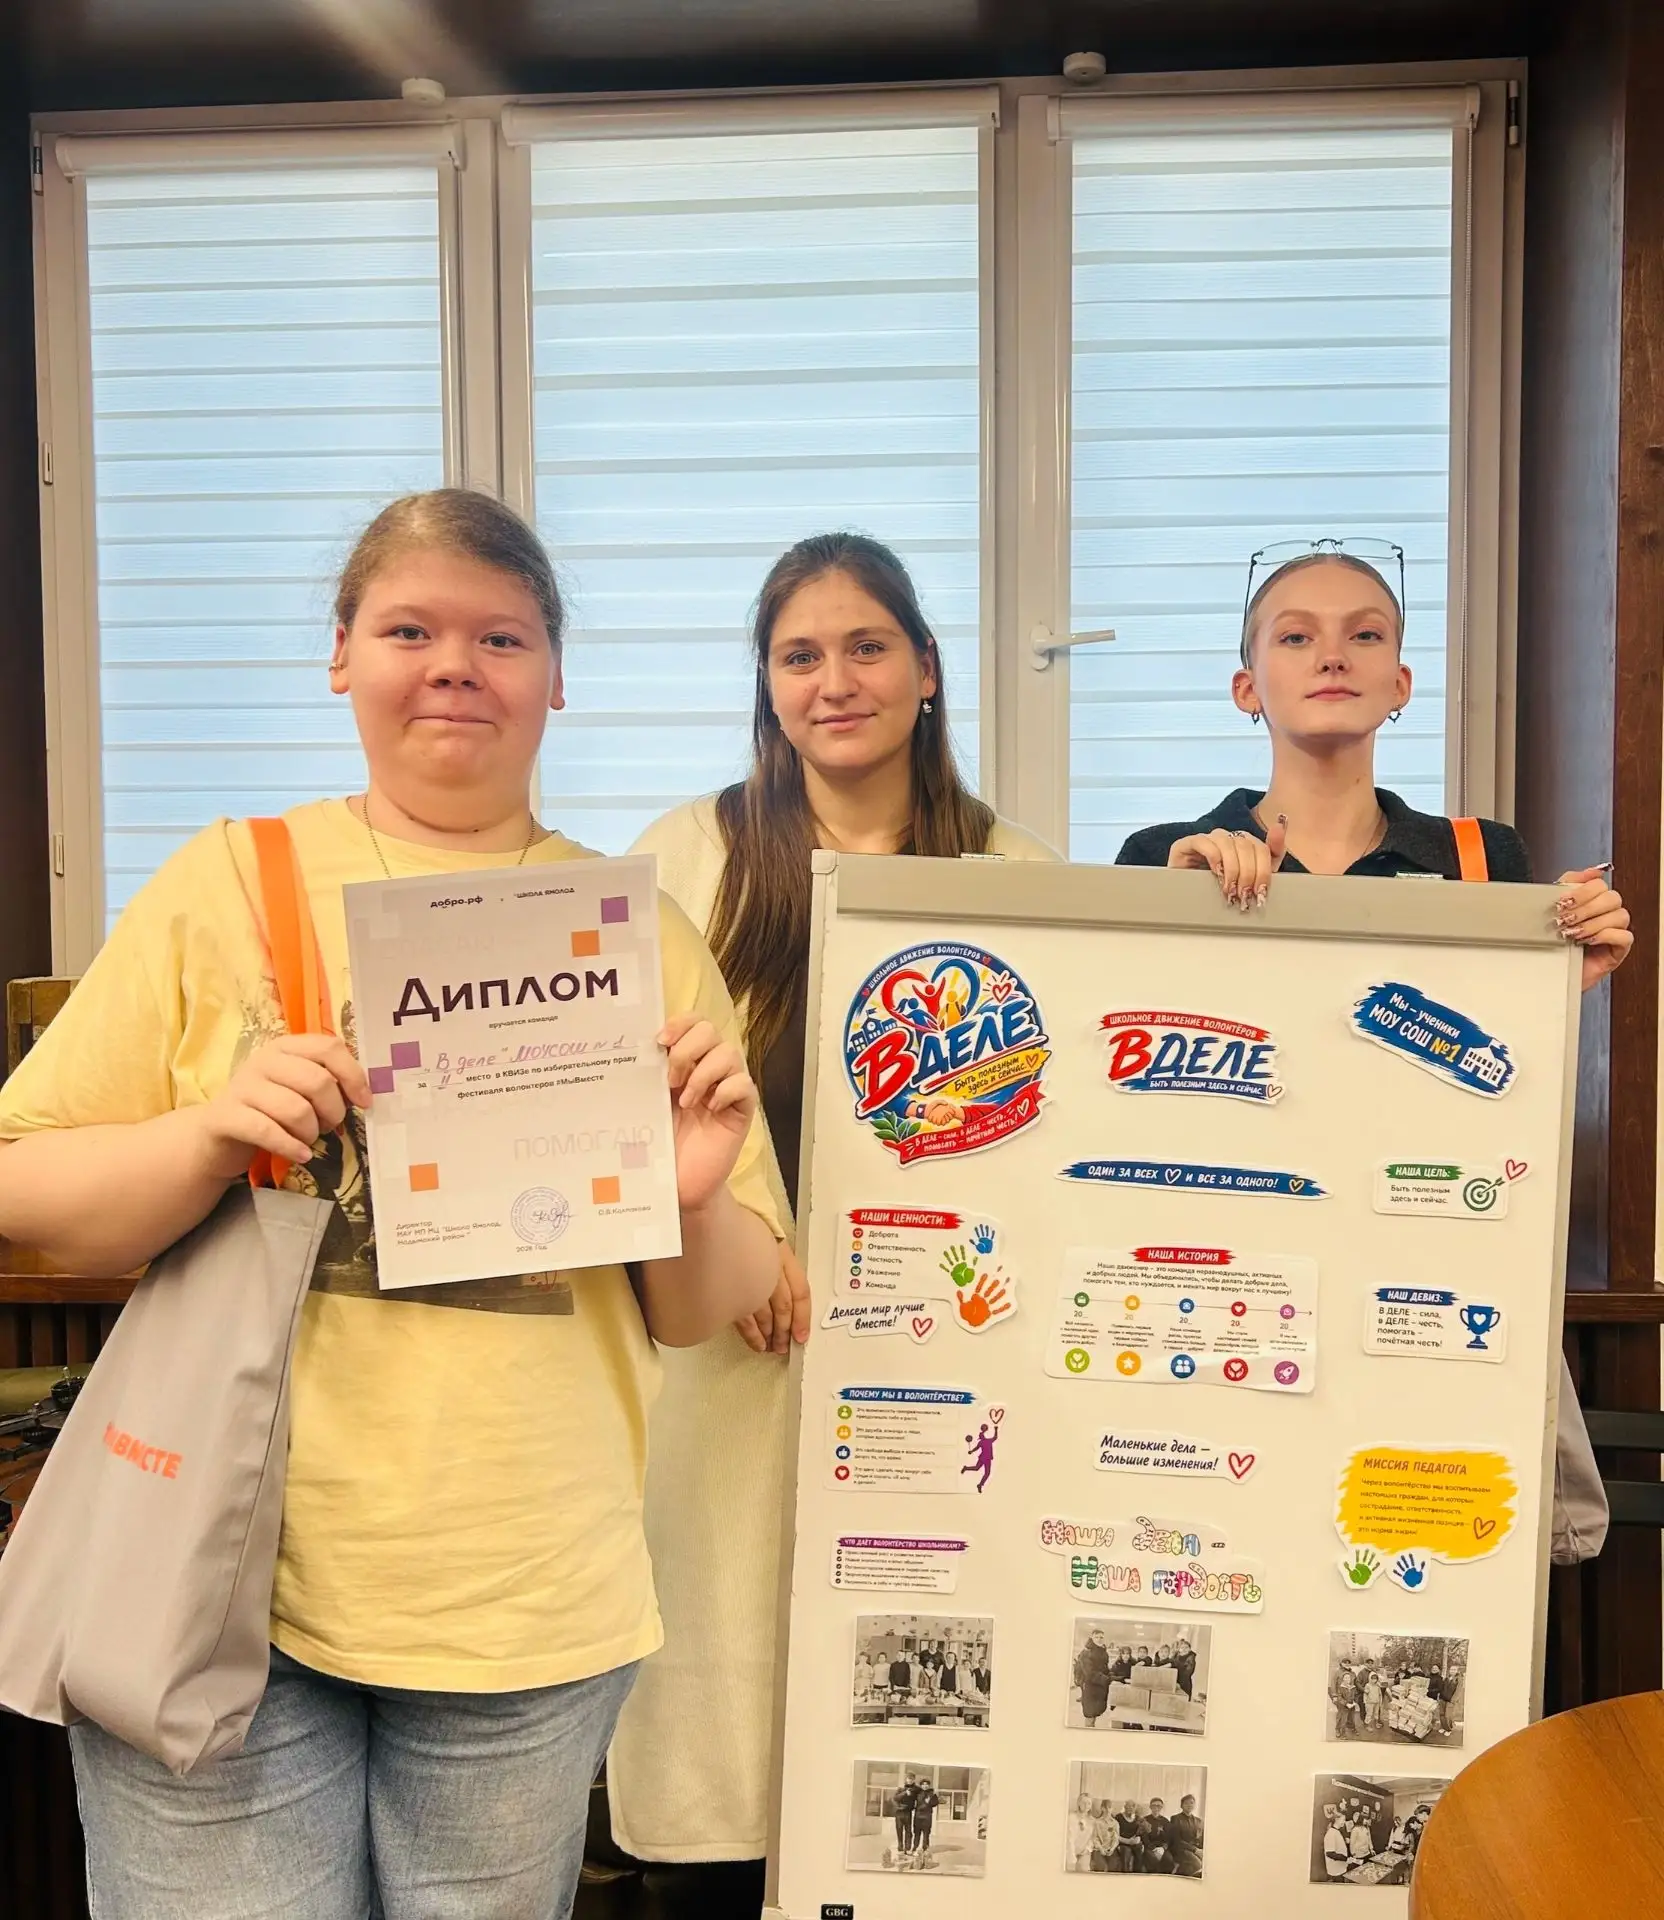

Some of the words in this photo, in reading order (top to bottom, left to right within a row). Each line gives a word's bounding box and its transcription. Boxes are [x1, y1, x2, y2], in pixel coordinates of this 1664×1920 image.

[430, 895, 484, 908] добро.рф
[868, 960, 899, 989] ШКОЛЬНОЕ
[899, 946, 935, 966] ДВИЖЕНИЕ
[392, 968, 619, 1027] Диплом
[1389, 992, 1409, 1011] Мы
[1416, 1010, 1461, 1039] ученики
[489, 1019, 526, 1029] вручается
[1109, 1013, 1152, 1026] ШКОЛЬНОЕ
[1154, 1014, 1201, 1027] ДВИЖЕНИЕ
[1203, 1019, 1258, 1038] ВОЛОНТЁРОВ
[1368, 1003, 1402, 1030] МОУ
[1400, 1020, 1433, 1048] СОШ
[1429, 1036, 1462, 1064] №1
[852, 1028, 916, 1113] В
[912, 998, 1035, 1086] ДЕЛЕ
[1107, 1028, 1153, 1081] В
[1144, 1032, 1277, 1080] ДЕЛЕ
[465, 1073, 491, 1082] место
[531, 1066, 542, 1074] по
[543, 1057, 611, 1073] избирательному
[613, 1055, 638, 1066] праву
[954, 1075, 976, 1092] Быть
[978, 1056, 1019, 1079] полезным
[457, 1088, 504, 1099] фестиваля
[505, 1081, 555, 1093] волонтеров
[968, 1079, 989, 1094] здесь
[1149, 1080, 1169, 1088] БЫТЬ
[1170, 1080, 1207, 1089] ПОЛЕЗНЫМ
[1208, 1081, 1228, 1091] ЗДЕСЬ
[1229, 1083, 1235, 1091] И
[1087, 1164, 1115, 1177] ОДИН
[1118, 1166, 1131, 1178] ЗА
[1134, 1167, 1159, 1180] ВСЕХ
[1185, 1171, 1193, 1182] И
[1197, 1173, 1217, 1185] ВСЕ
[1219, 1174, 1233, 1186] ЗА
[1236, 1175, 1278, 1188] ОДНОГО!
[1395, 1166, 1422, 1177] НАША
[1423, 1166, 1450, 1178] ЦЕЛЬ:
[1390, 1184, 1411, 1193] Быть
[1411, 1186, 1451, 1194] полезным
[1390, 1196, 1412, 1204] здесь
[860, 1212, 890, 1222] НАШИ
[893, 1212, 946, 1226] ЦЕННОСТИ:
[868, 1230, 899, 1239] Доброта
[867, 1243, 926, 1253] Ответственность
[1147, 1249, 1175, 1261] НАША
[1177, 1250, 1220, 1262] ИСТОРИЯ
[866, 1268, 901, 1277] Уважение
[865, 1281, 897, 1290] Команда
[1387, 1290, 1409, 1300] НАШ
[1409, 1291, 1444, 1303] ДЕВИЗ:
[870, 1305, 892, 1316] мир
[894, 1303, 925, 1316] лучше
[1385, 1307, 1410, 1317] ДЕЛЕ
[855, 1315, 897, 1330] вместе!
[1384, 1317, 1409, 1326] ДЕЛЕ
[1377, 1328, 1416, 1336] помогать
[1376, 1336, 1415, 1346] почётная
[1416, 1338, 1443, 1348] честь!
[849, 1389, 880, 1399] ПОЧЕМУ
[881, 1390, 895, 1399] МЫ
[904, 1390, 965, 1402] ВОЛОНТЁРСТВЕ?
[1100, 1435, 1168, 1451] Маленькие
[1170, 1439, 1197, 1454] дела
[1099, 1450, 1150, 1466] большие
[1152, 1456, 1219, 1471] изменения!
[1362, 1457, 1409, 1472] МИССИЯ
[1413, 1460, 1467, 1475] ПЕДАГОГА
[1383, 1481, 1431, 1490] волонтёрство
[1445, 1485, 1491, 1493] воспитываем
[825, 1908, 849, 1917] GBG
